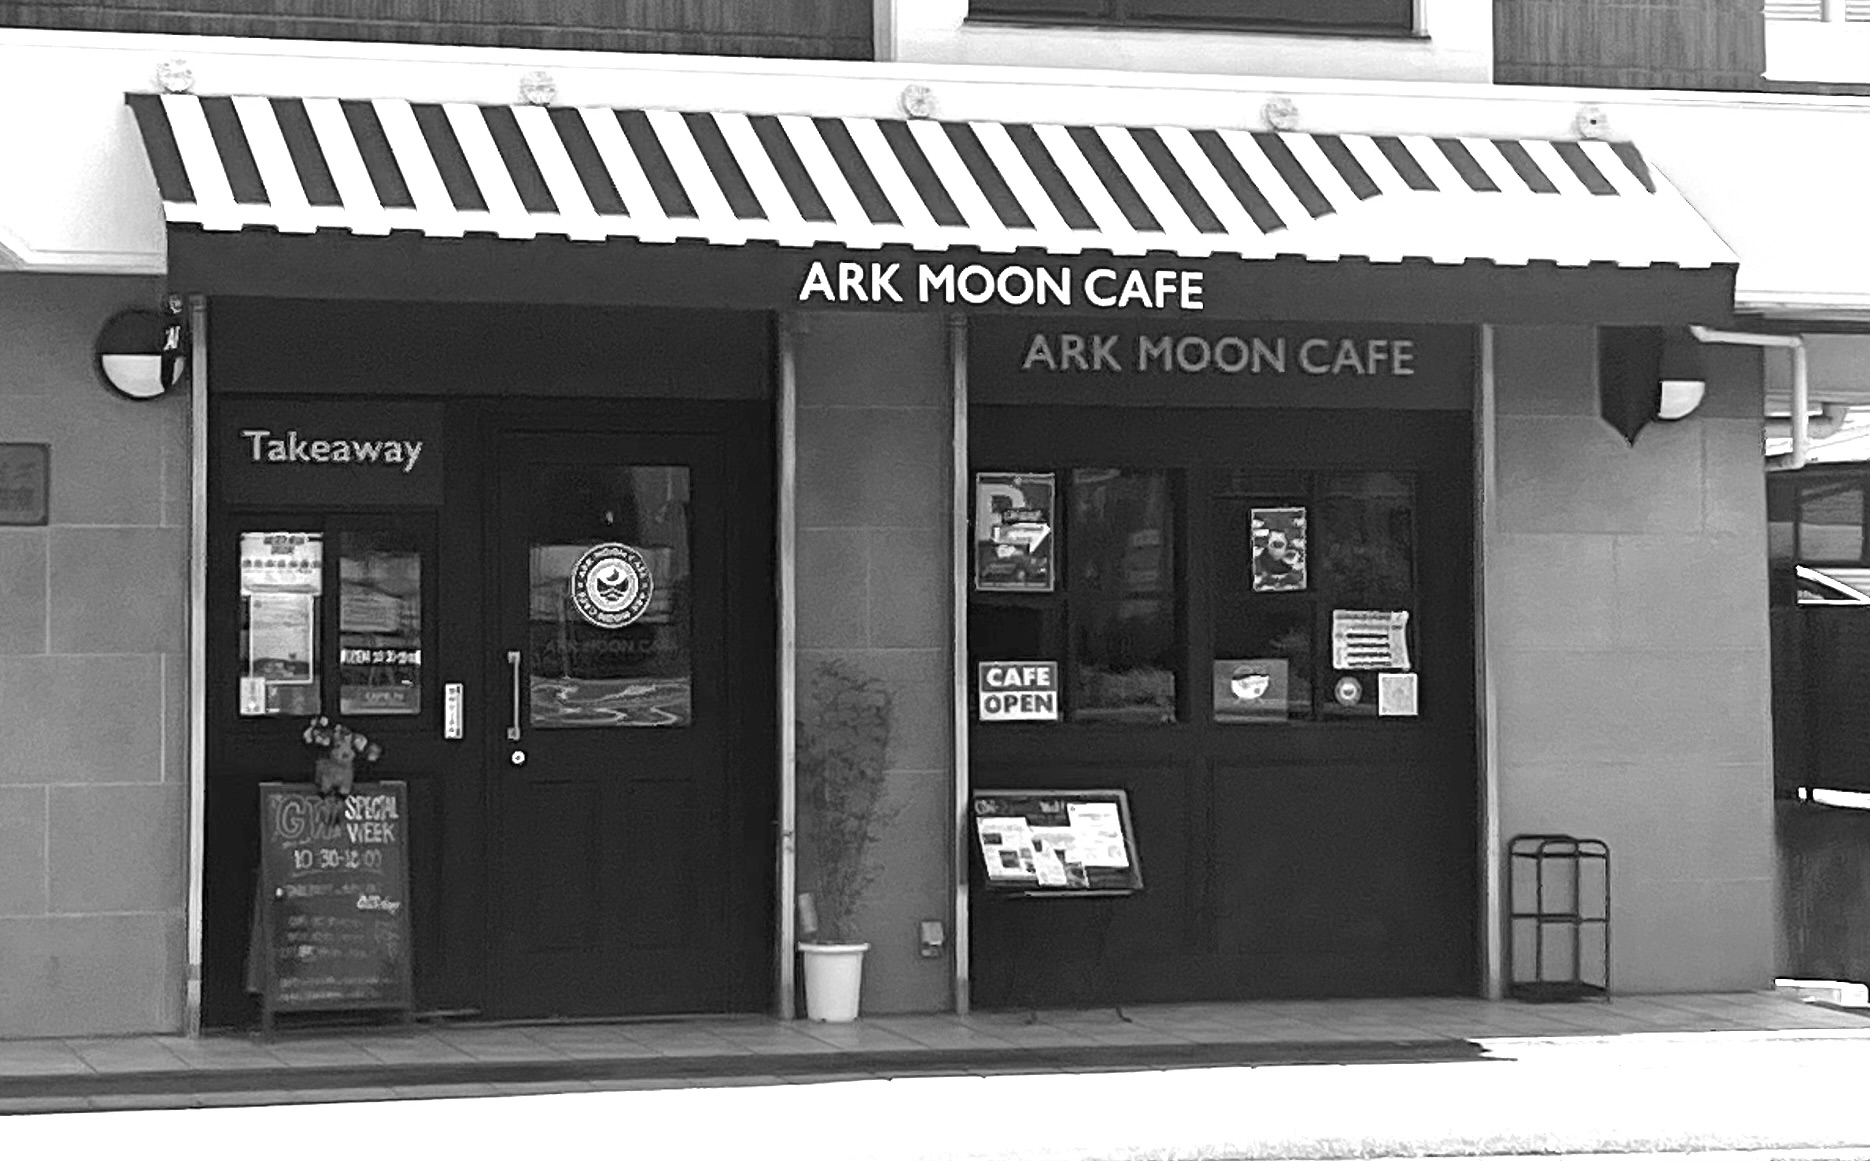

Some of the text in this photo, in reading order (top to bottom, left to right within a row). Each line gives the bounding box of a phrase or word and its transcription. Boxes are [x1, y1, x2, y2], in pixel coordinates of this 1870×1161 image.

[799, 261, 1204, 310] ARK MOON CAFE
[1023, 334, 1415, 376] ARK MOON CAFE
[242, 430, 423, 474] Takeaway
[986, 667, 1050, 687] CAFE
[984, 694, 1053, 714] OPEN
[346, 821, 396, 844] WEEK
